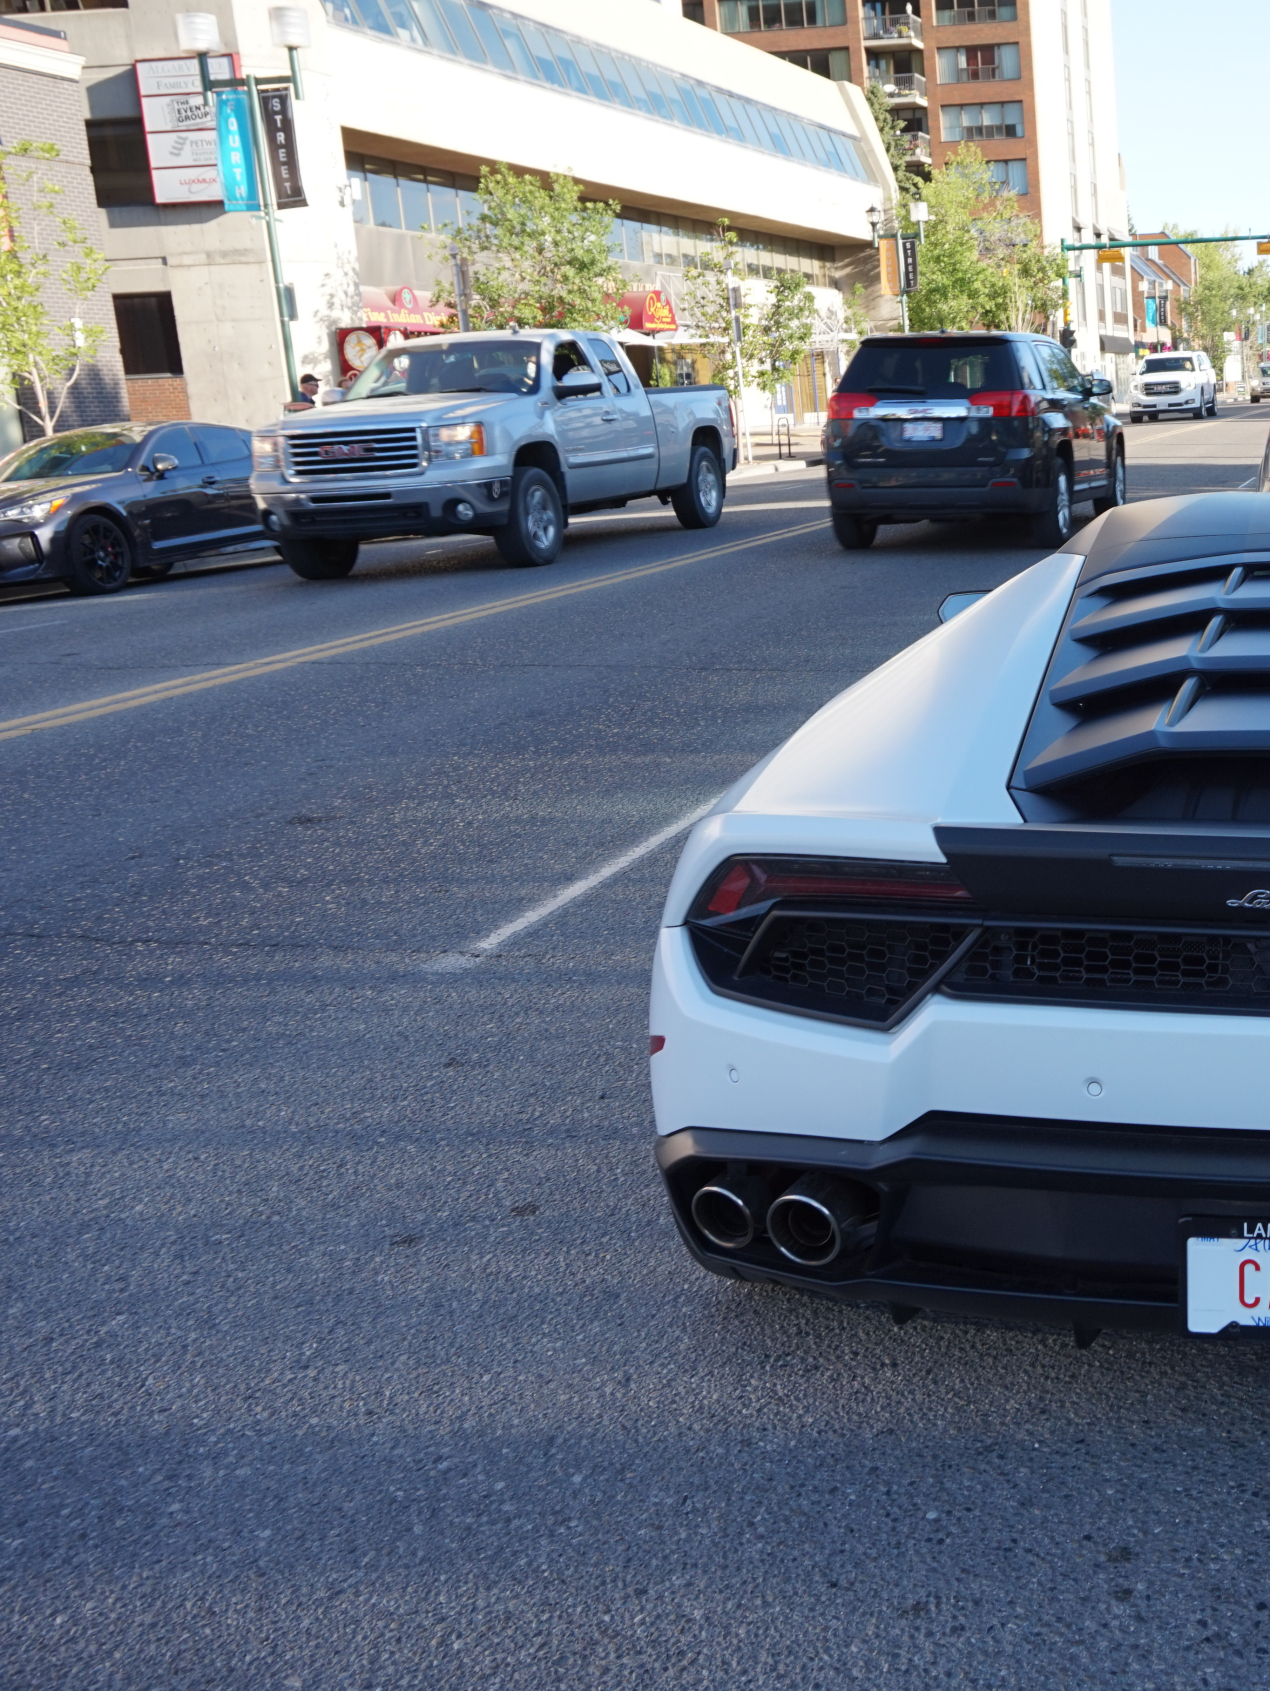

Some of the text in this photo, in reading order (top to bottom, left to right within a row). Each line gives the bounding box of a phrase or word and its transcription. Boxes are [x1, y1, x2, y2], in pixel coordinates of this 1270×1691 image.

[176, 99, 190, 107] THE
[177, 104, 207, 116] EVENT
[177, 111, 210, 123] GROUP
[227, 101, 246, 198] FOURTH
[272, 98, 292, 195] STREET
[905, 242, 915, 287] STREET
[387, 309, 423, 325] Indian
[318, 443, 376, 459] GMC
